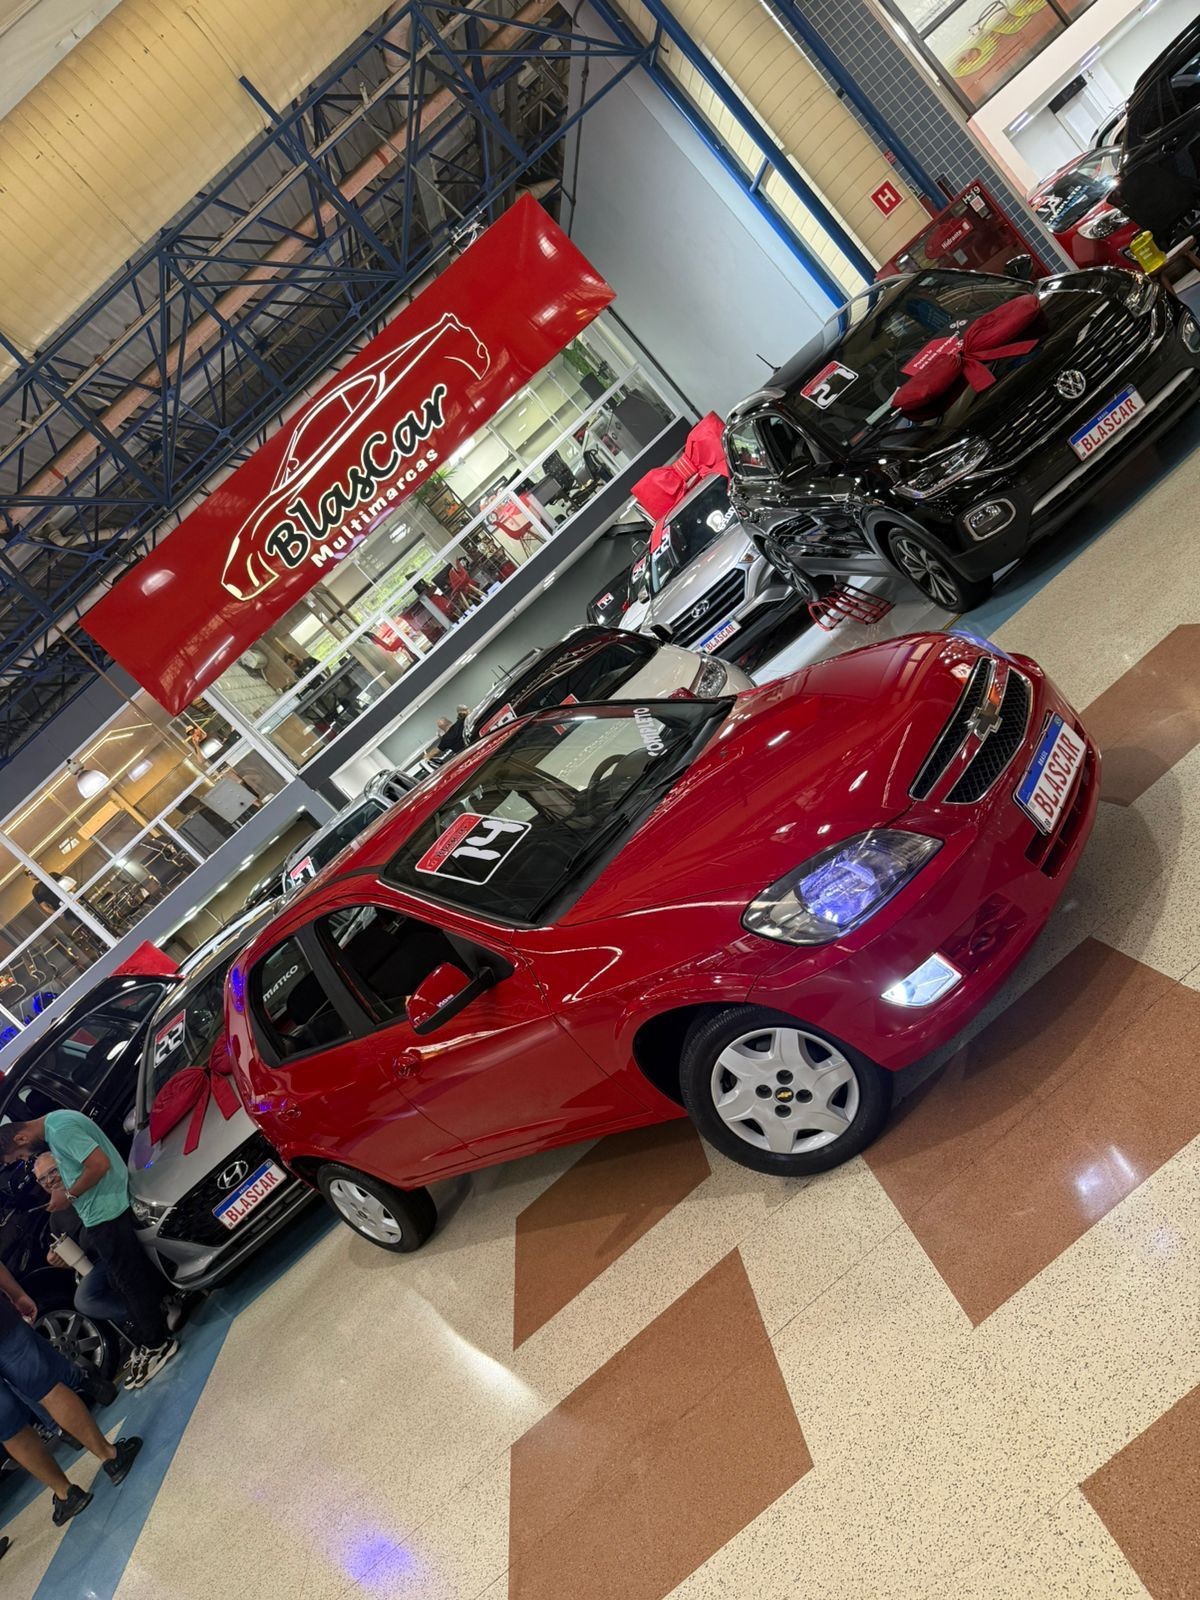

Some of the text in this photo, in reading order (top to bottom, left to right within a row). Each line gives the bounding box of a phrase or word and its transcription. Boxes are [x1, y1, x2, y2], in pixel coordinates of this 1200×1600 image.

[877, 187, 896, 209] H
[941, 229, 962, 250] Hidrante
[1080, 398, 1138, 453] BLASCAR
[265, 383, 447, 568] BlasCar
[310, 448, 439, 569] Multimarcas
[706, 624, 736, 651] BLASCAR
[1033, 732, 1081, 819] BLASCAR
[451, 820, 524, 861] 14
[155, 1021, 184, 1061] 22
[224, 1171, 280, 1224] BLASCAR
